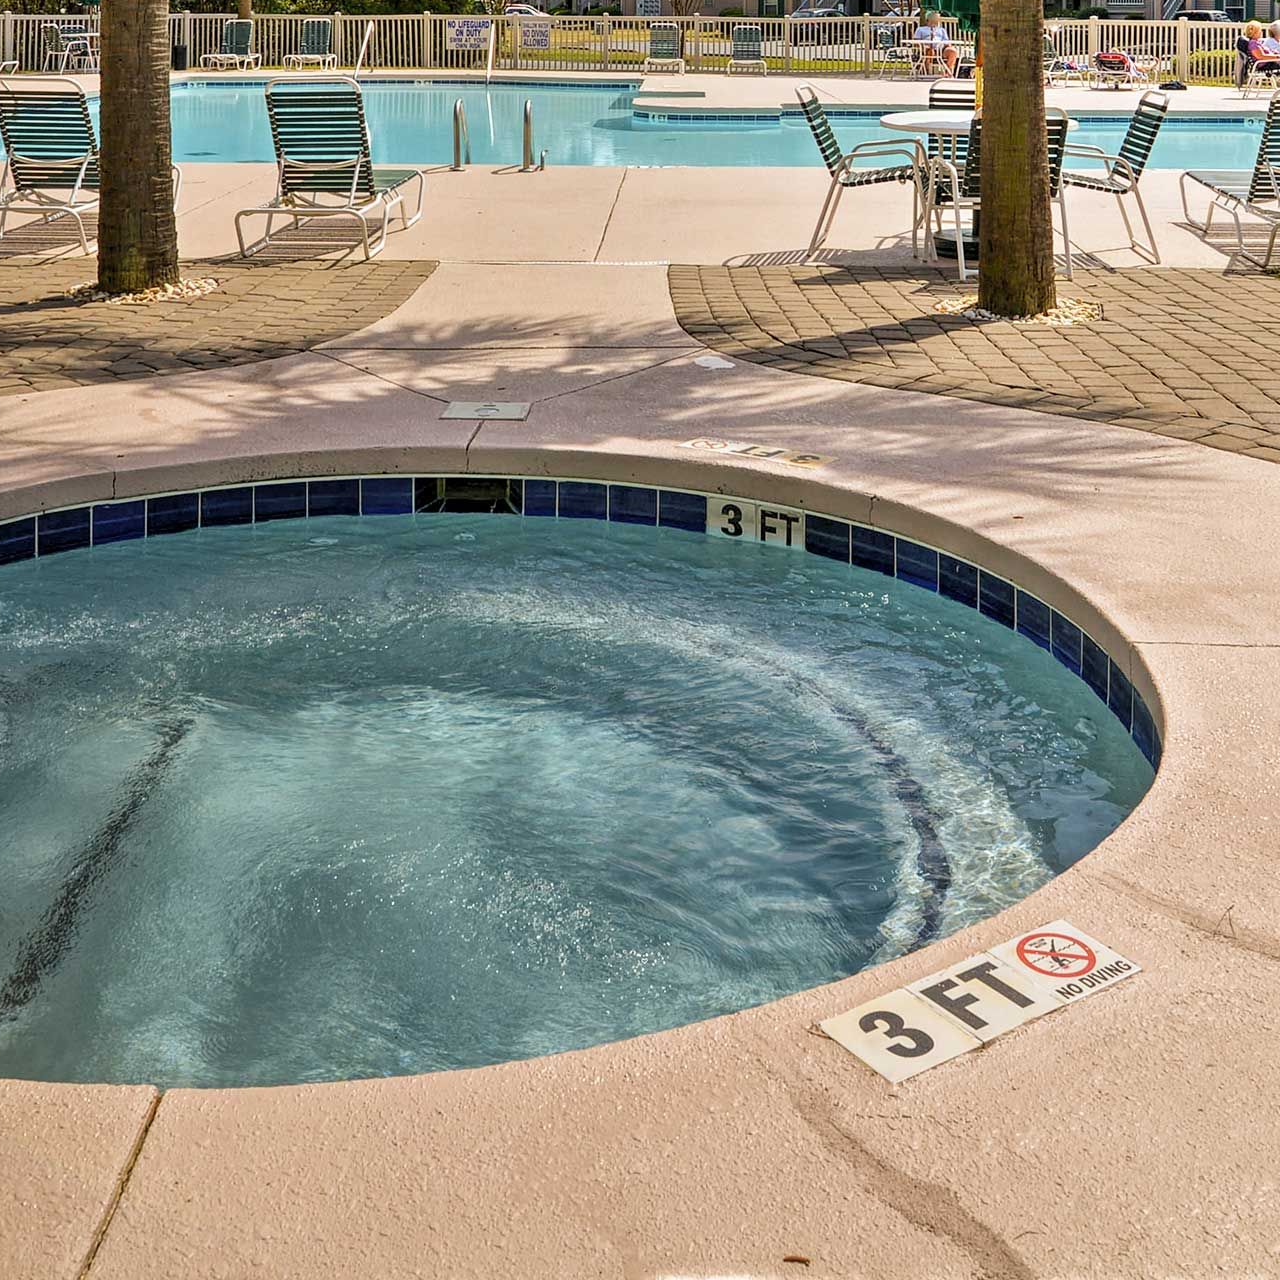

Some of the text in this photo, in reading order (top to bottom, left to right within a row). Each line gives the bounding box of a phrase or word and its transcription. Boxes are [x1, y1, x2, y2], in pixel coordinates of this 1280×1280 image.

[455, 29, 482, 37] ON DUTY
[531, 30, 549, 38] DIVING
[523, 39, 548, 47] ALLOWED
[731, 446, 821, 464] 3 FT
[721, 504, 800, 547] 3 FT
[1055, 960, 1132, 1000] NO DIVING
[858, 961, 1035, 1058] 3 FT
